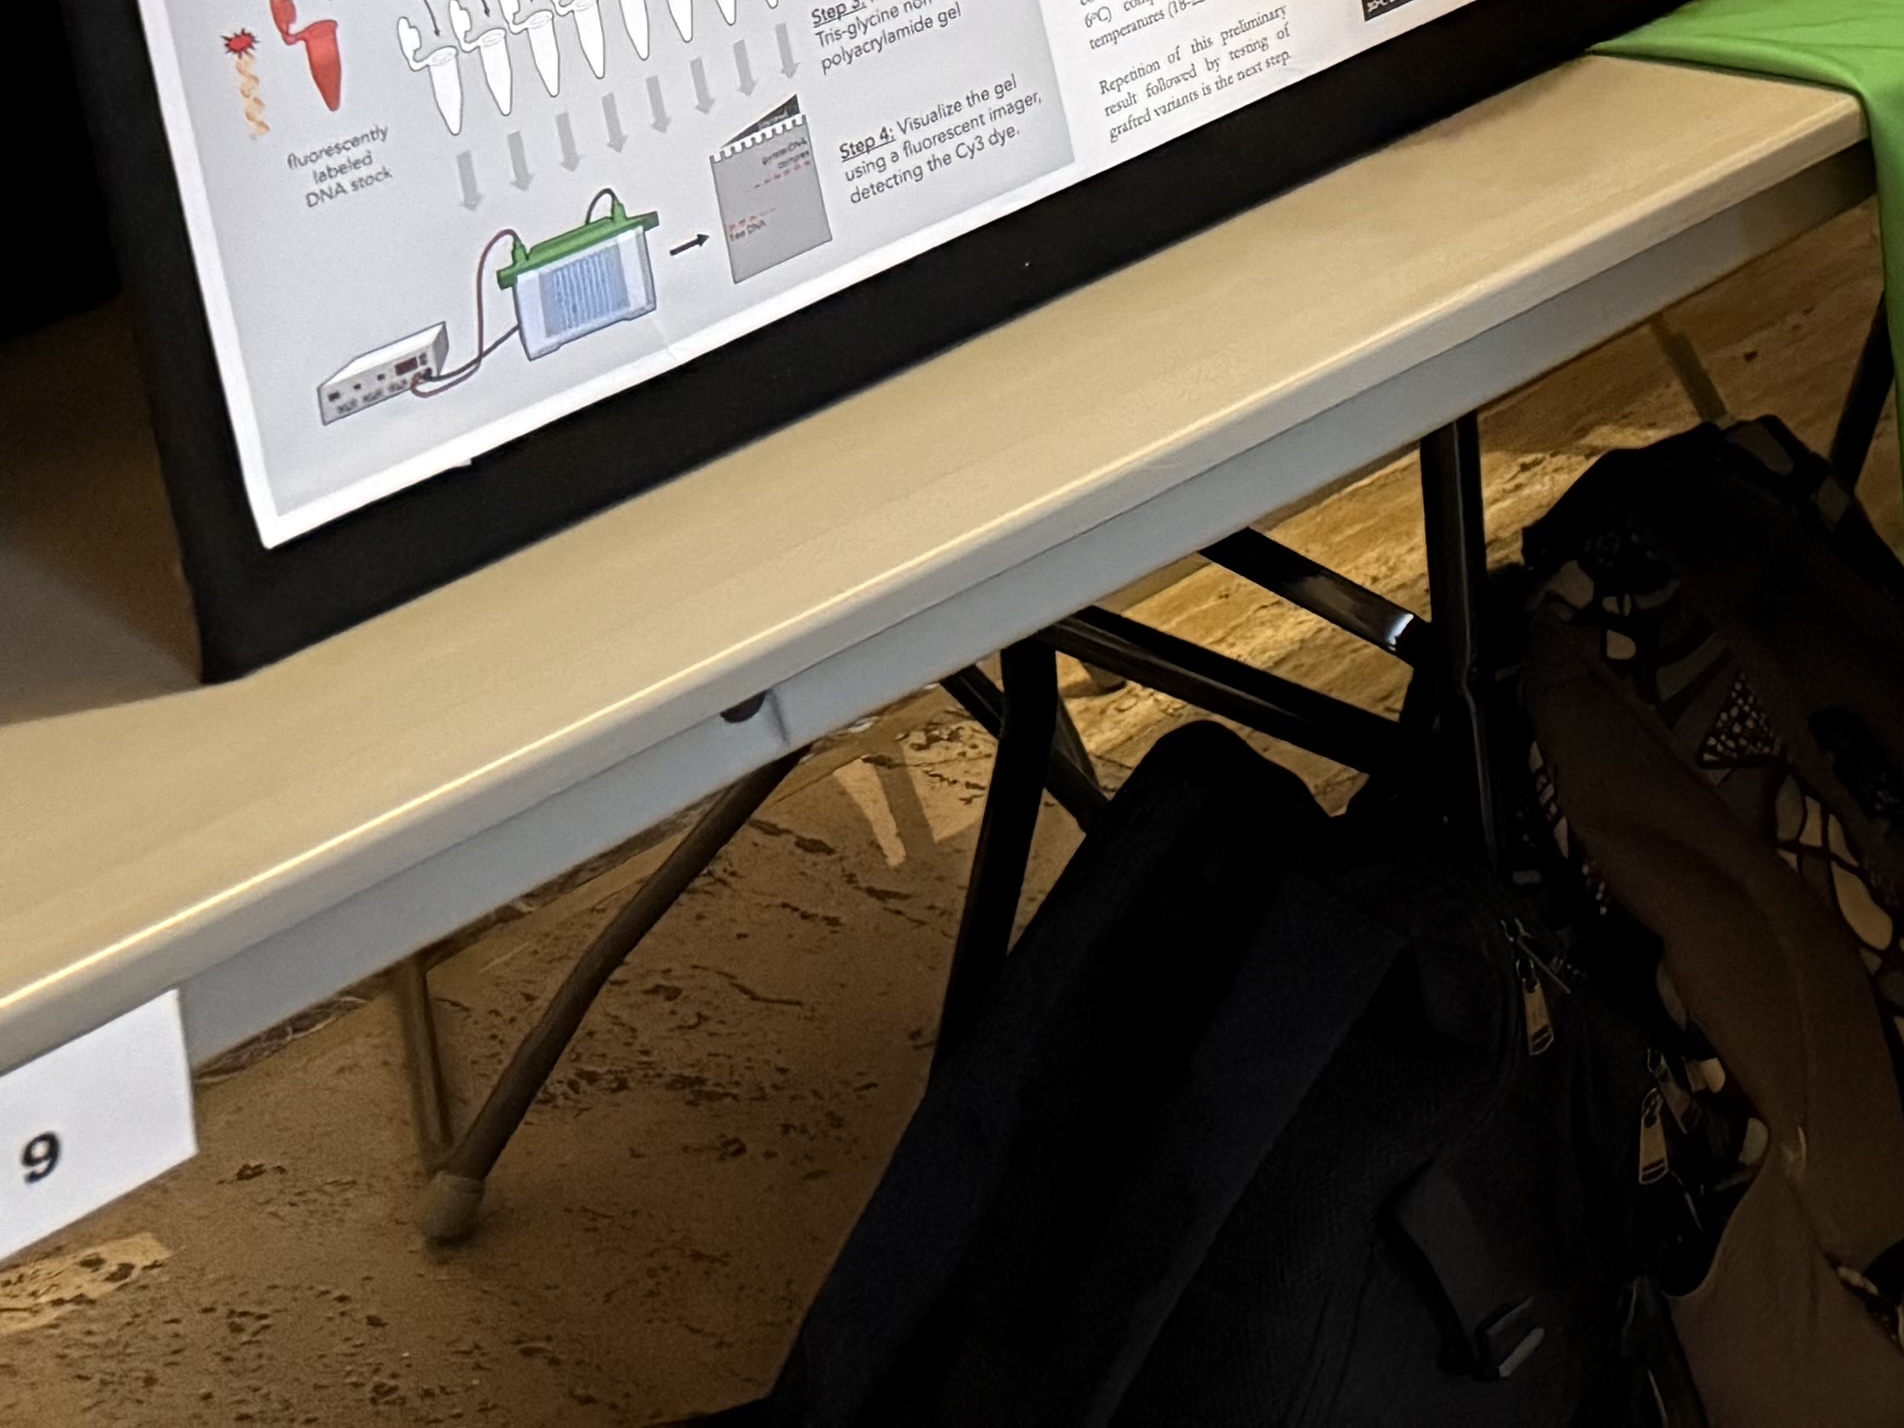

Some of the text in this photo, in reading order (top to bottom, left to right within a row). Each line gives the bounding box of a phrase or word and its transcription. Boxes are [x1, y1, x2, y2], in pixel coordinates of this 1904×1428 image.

[849, 126, 1020, 204] detecting the Cy3 dye.
[20, 1129, 61, 1185] 9
